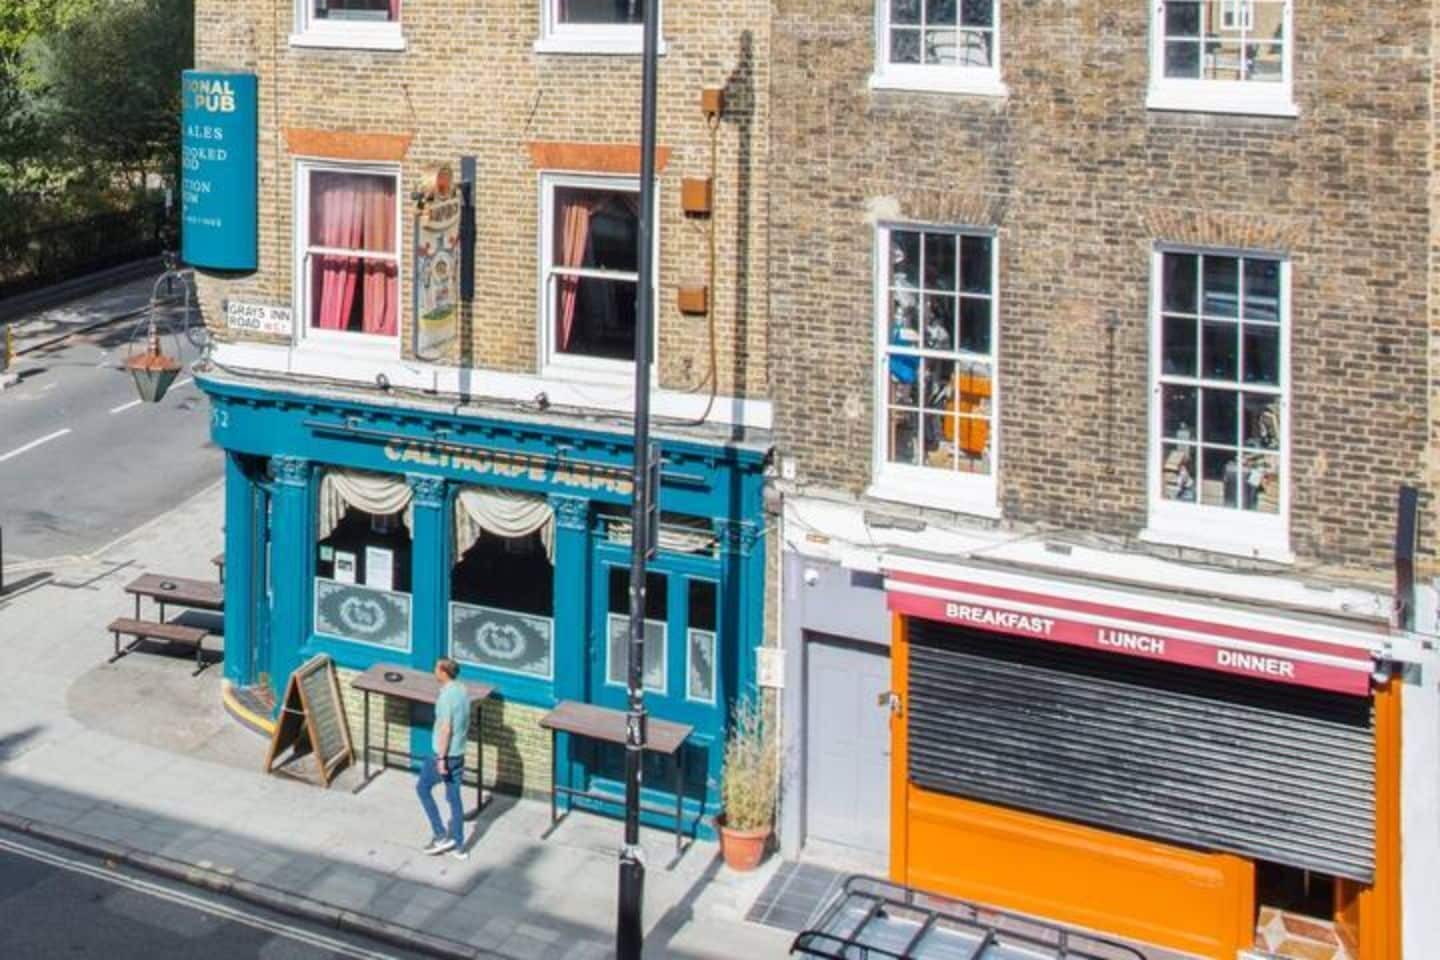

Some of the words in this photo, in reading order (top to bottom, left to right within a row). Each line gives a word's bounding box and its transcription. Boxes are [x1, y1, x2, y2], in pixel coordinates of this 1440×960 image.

[195, 94, 236, 112] PUB
[187, 125, 224, 140] ALES
[229, 316, 261, 329] ROAD
[270, 309, 291, 321] INN
[384, 439, 547, 481] CALTHORPE
[551, 452, 633, 495] ARMS
[945, 602, 1055, 635] BREAKFAST
[1097, 628, 1166, 655] LUNCH
[1216, 649, 1295, 677] DINNER
